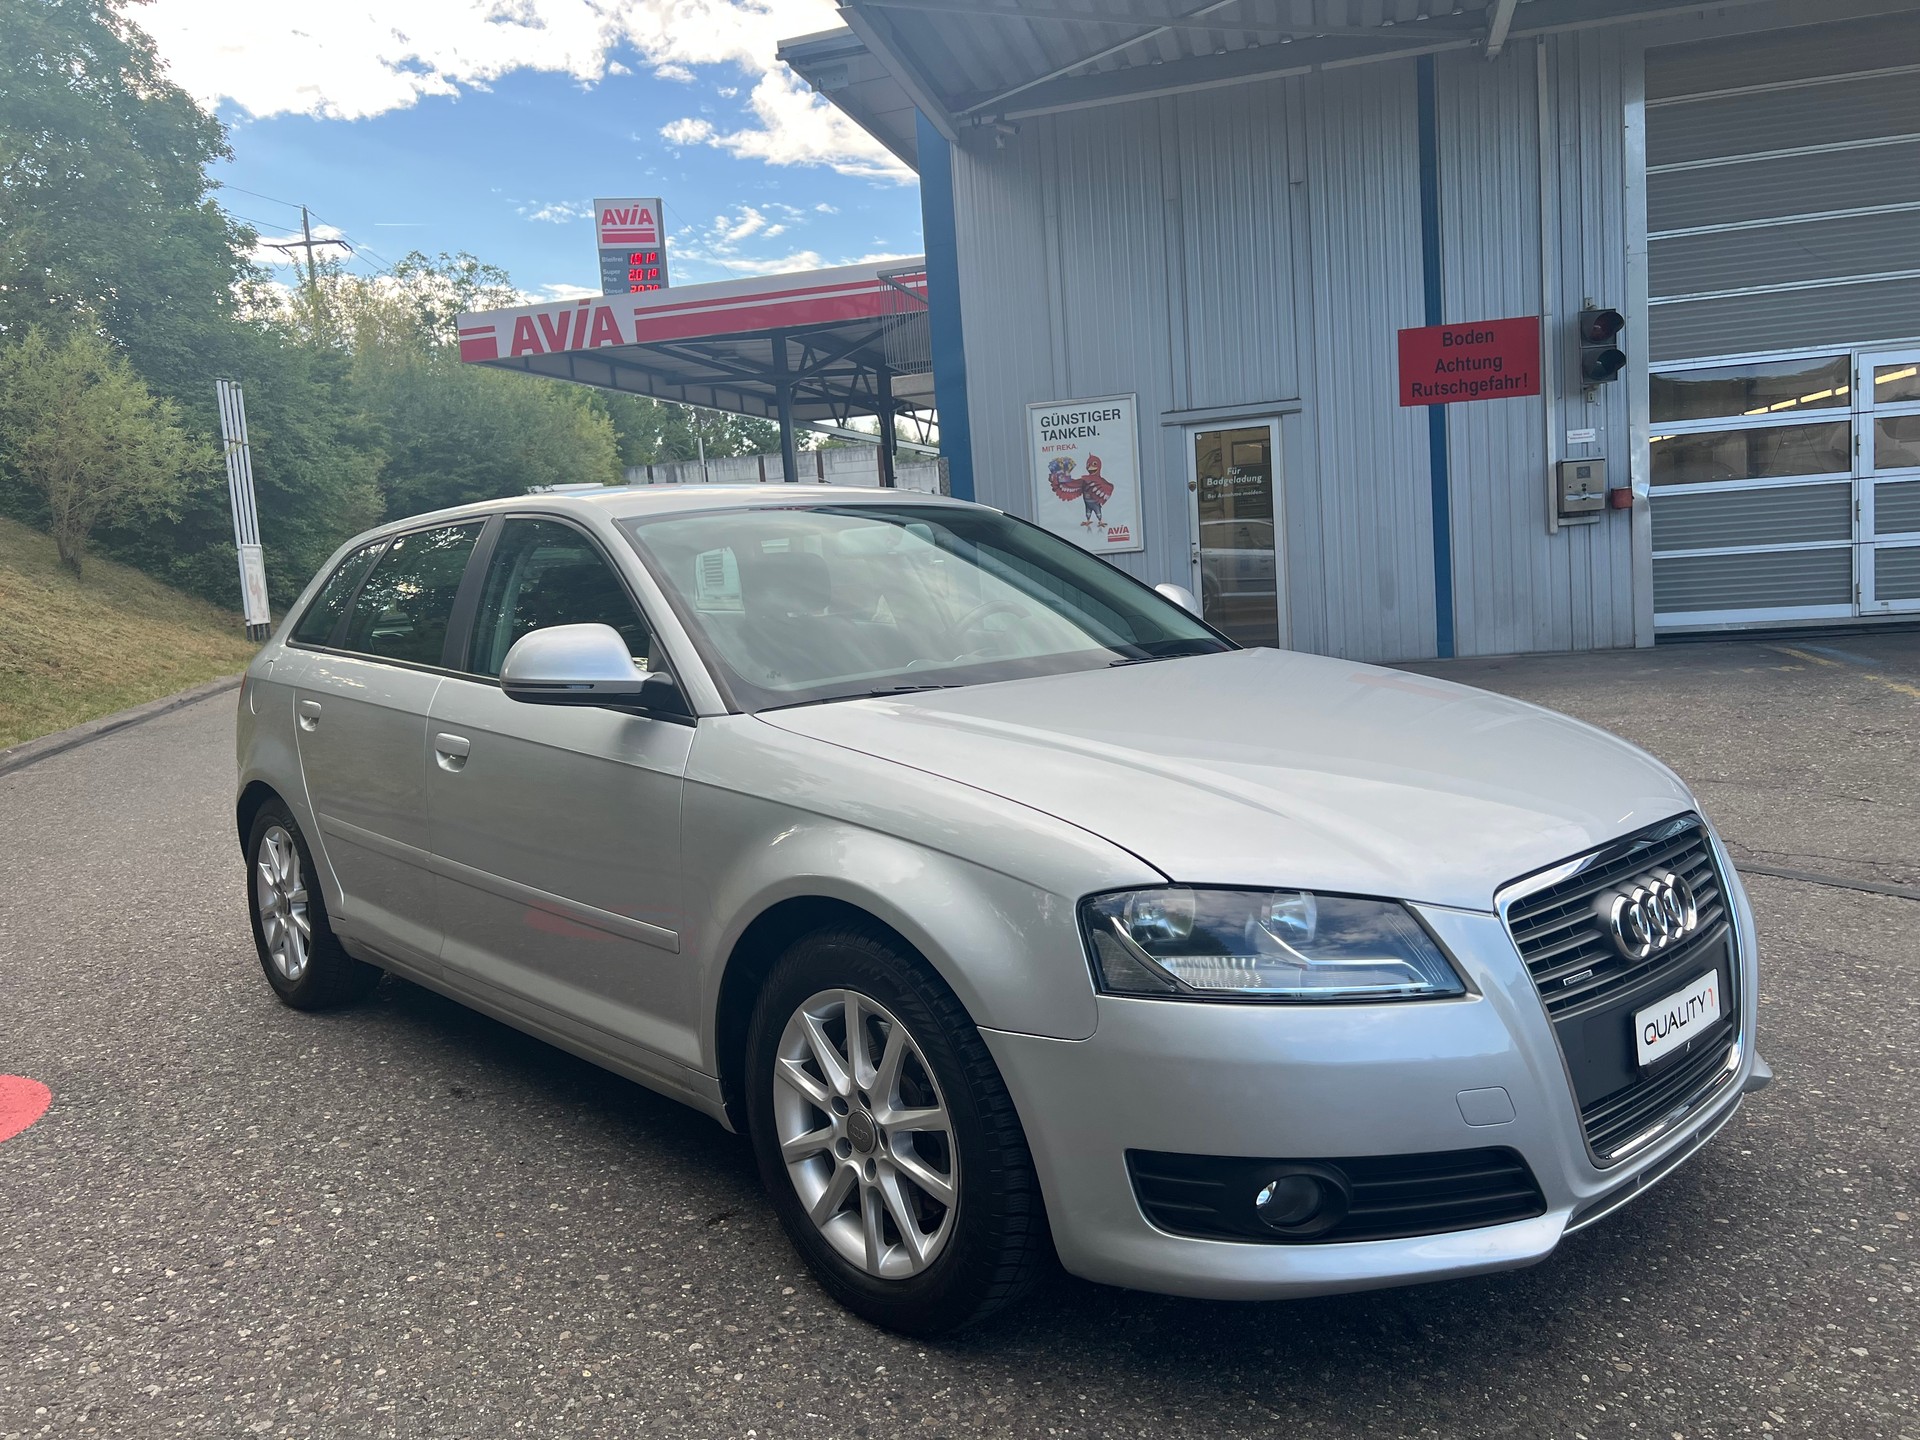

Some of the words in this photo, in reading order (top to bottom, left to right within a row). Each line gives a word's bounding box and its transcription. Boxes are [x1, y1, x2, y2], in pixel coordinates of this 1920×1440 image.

[1442, 329, 1494, 347] Boden
[1435, 356, 1503, 374] Achtung
[1411, 372, 1528, 398] Rutschgefahr!
[1040, 408, 1121, 428] GÜNSTIGER
[1041, 425, 1100, 442] TANKEN.
[1227, 467, 1241, 475] Für
